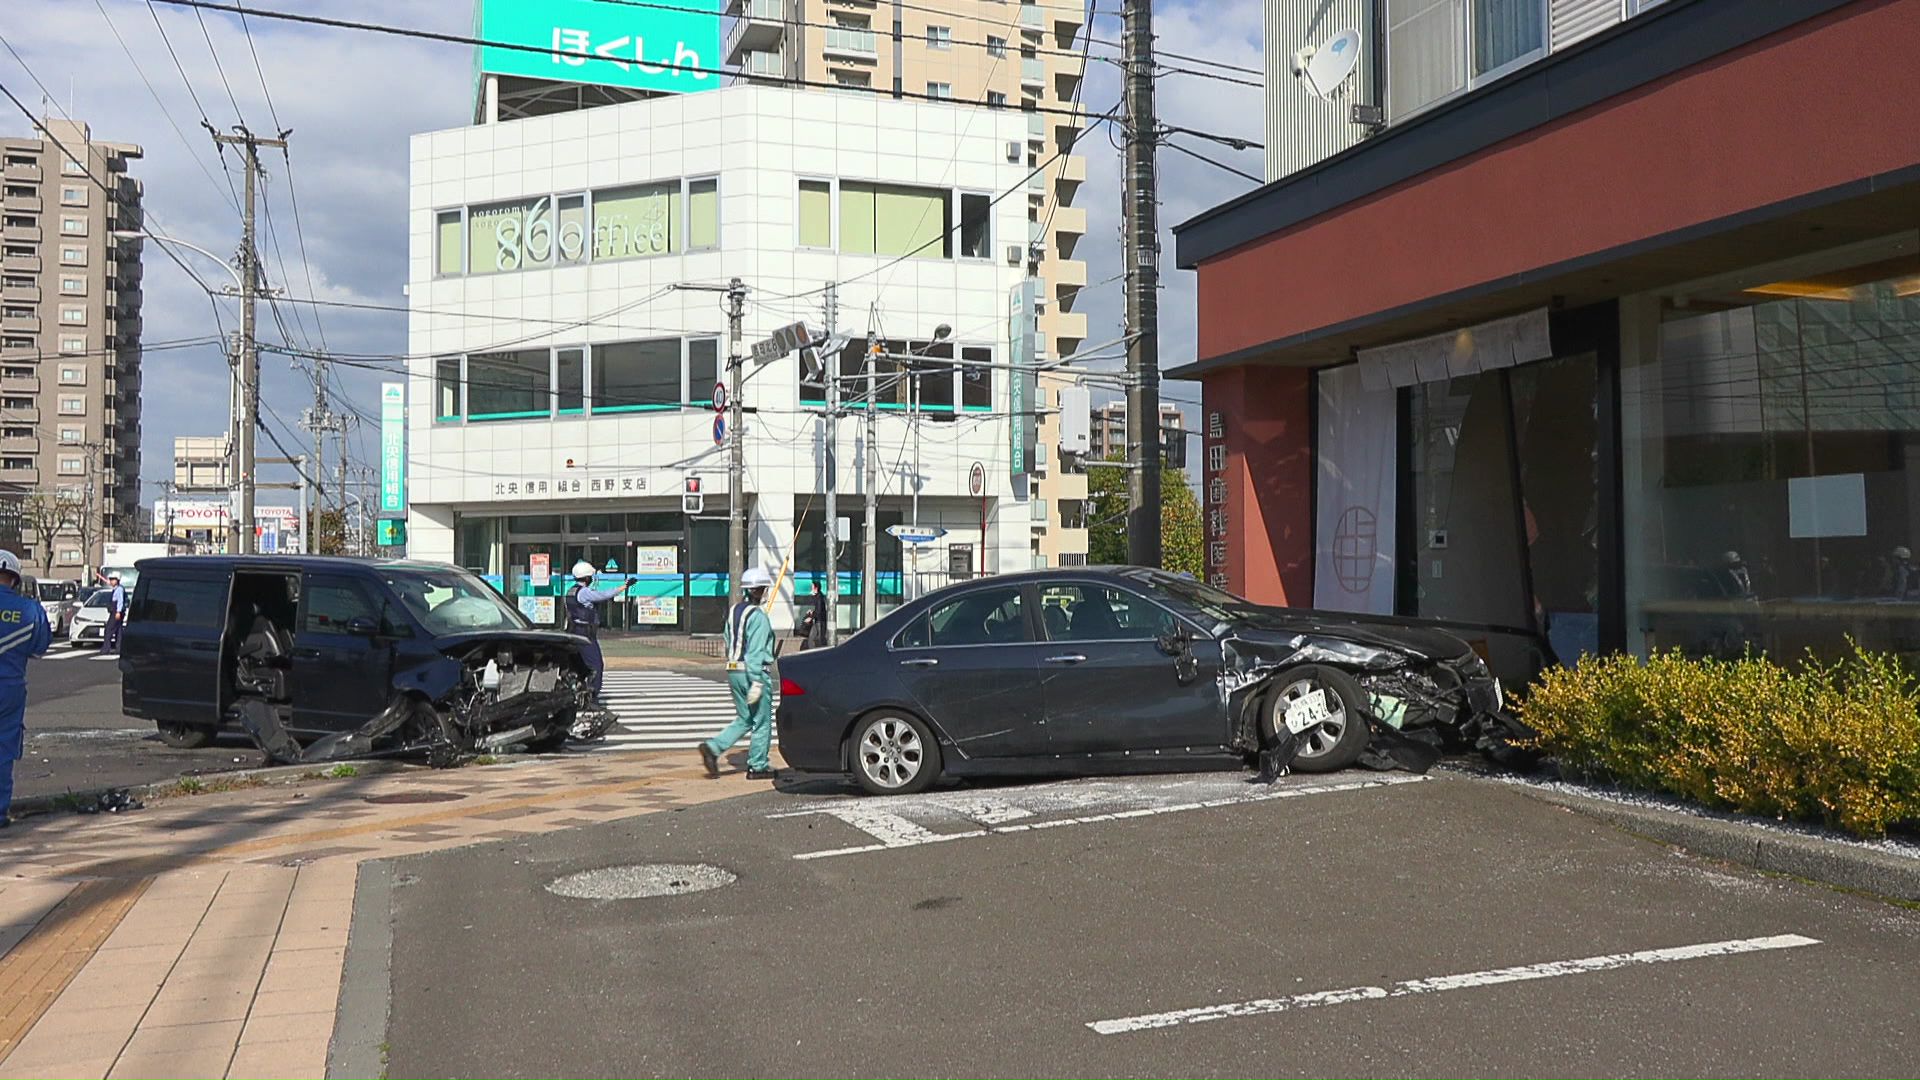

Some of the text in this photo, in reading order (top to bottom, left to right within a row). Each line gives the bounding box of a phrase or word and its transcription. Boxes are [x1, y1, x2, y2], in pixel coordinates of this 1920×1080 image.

[552, 27, 708, 79] ほくしん
[386, 432, 400, 508] 北央信用組合
[179, 509, 228, 518] TOYOTA
[260, 508, 291, 516] TOYOTA
